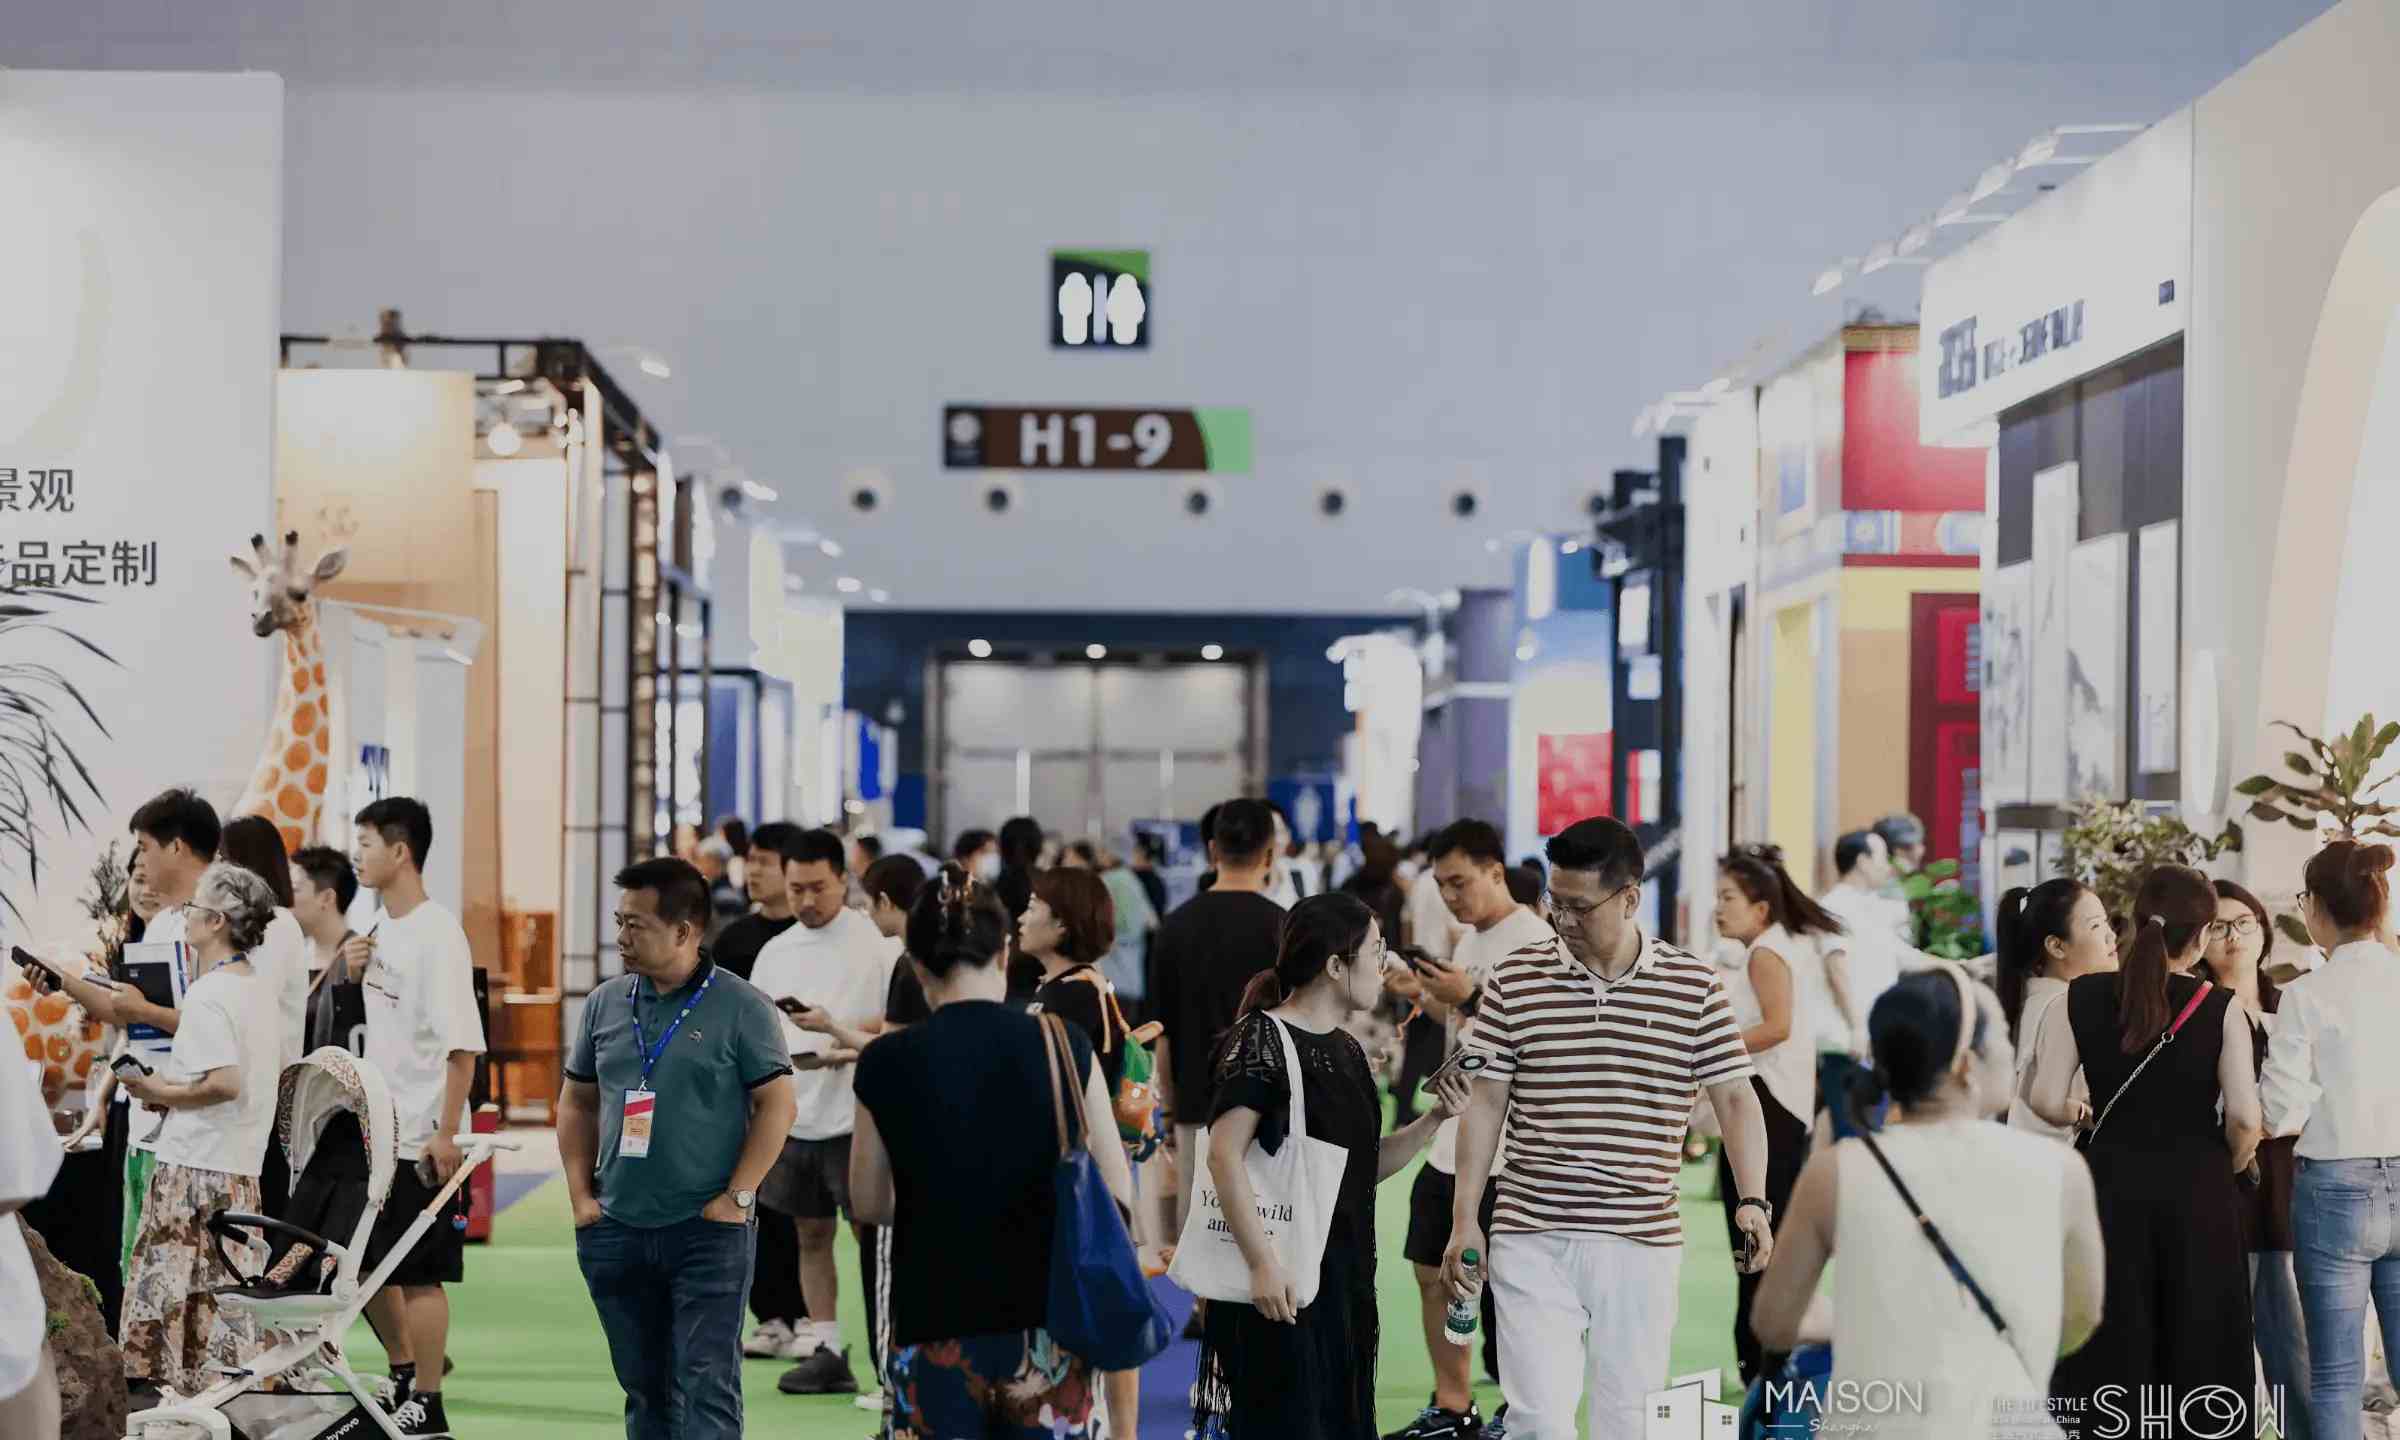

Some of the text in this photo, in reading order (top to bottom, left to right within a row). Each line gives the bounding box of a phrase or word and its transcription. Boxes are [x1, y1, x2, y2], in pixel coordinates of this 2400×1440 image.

[1020, 412, 1173, 467] H1-9
[0, 540, 157, 587] 品定制
[1201, 1190, 1293, 1222] Yo wild
